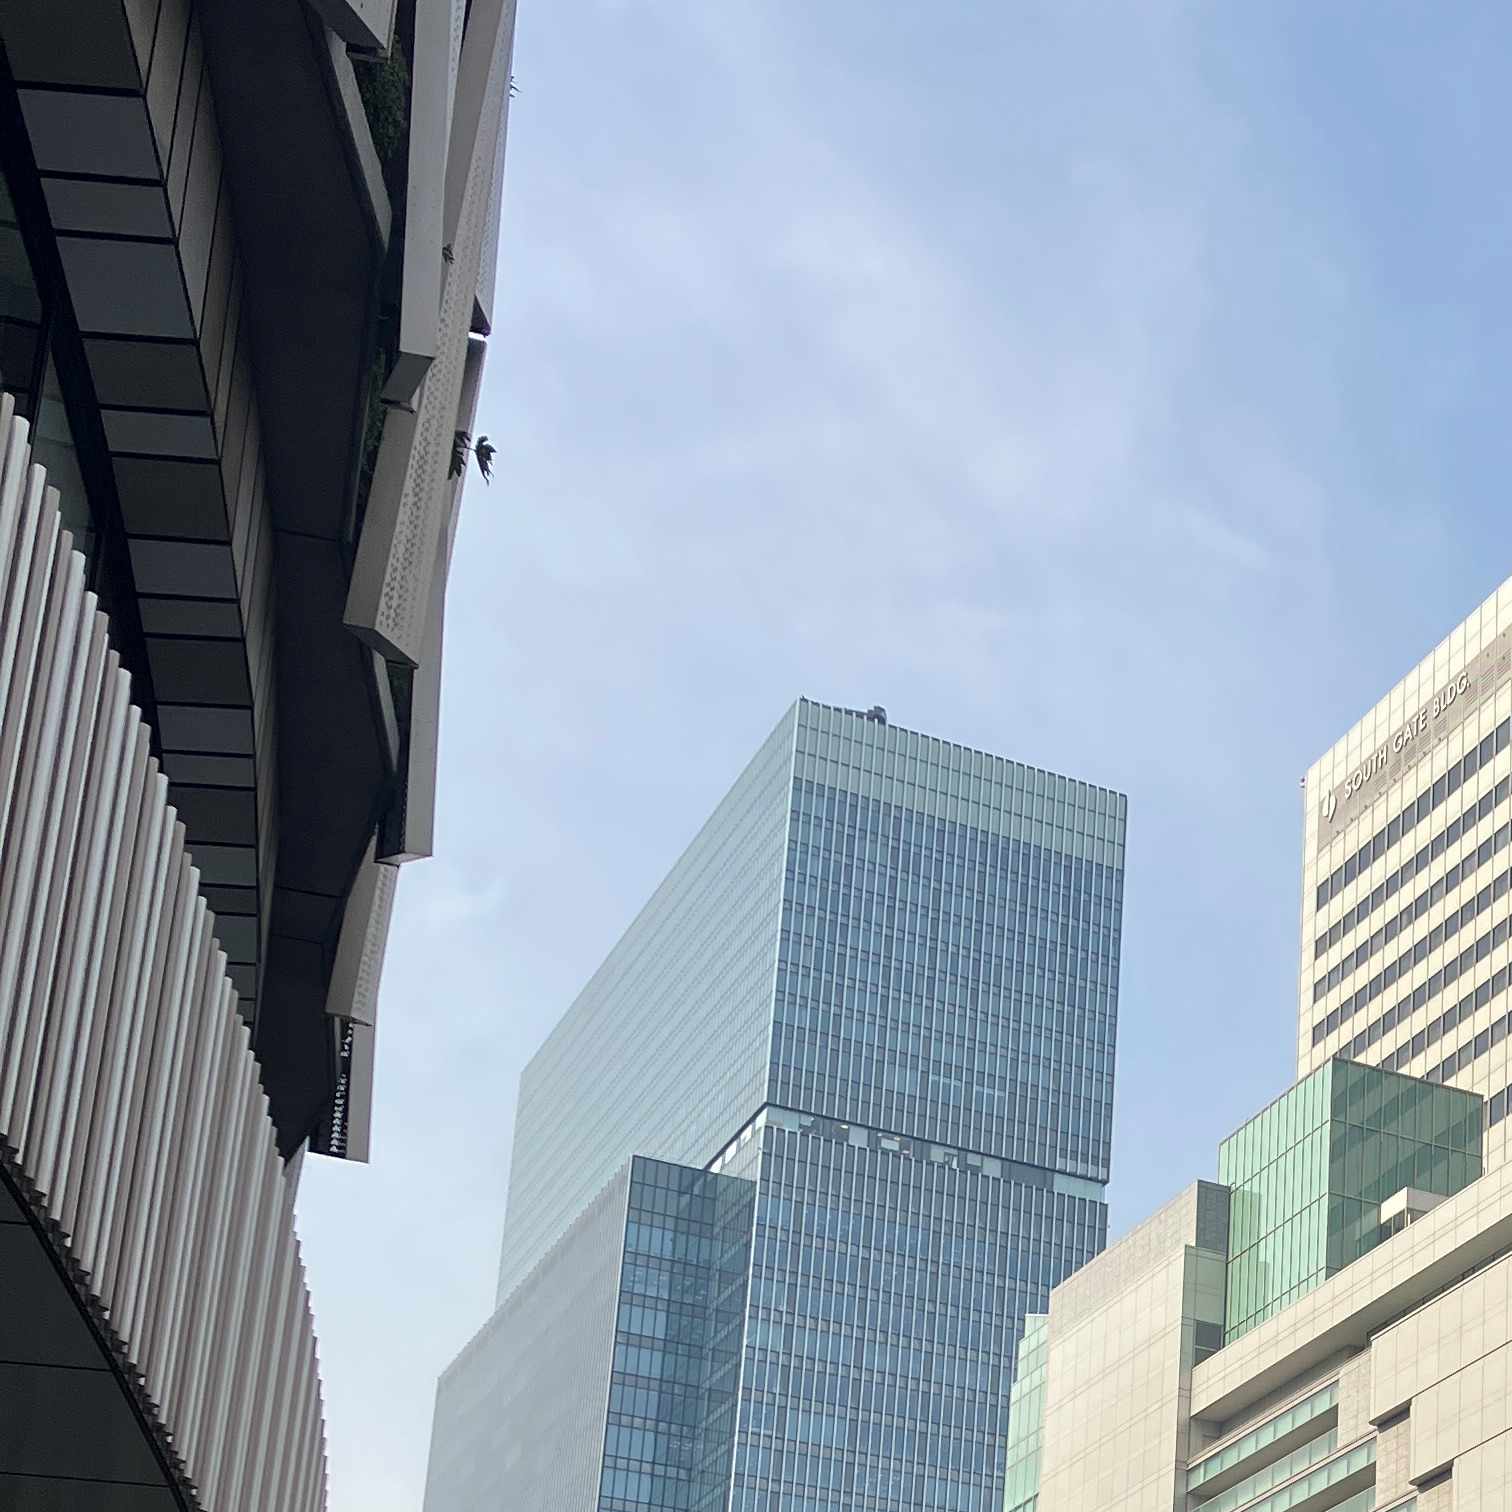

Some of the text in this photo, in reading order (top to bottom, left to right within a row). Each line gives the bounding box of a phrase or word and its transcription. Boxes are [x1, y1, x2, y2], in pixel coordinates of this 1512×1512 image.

[1344, 671, 1472, 800] SOUTH GATE BLDG.
